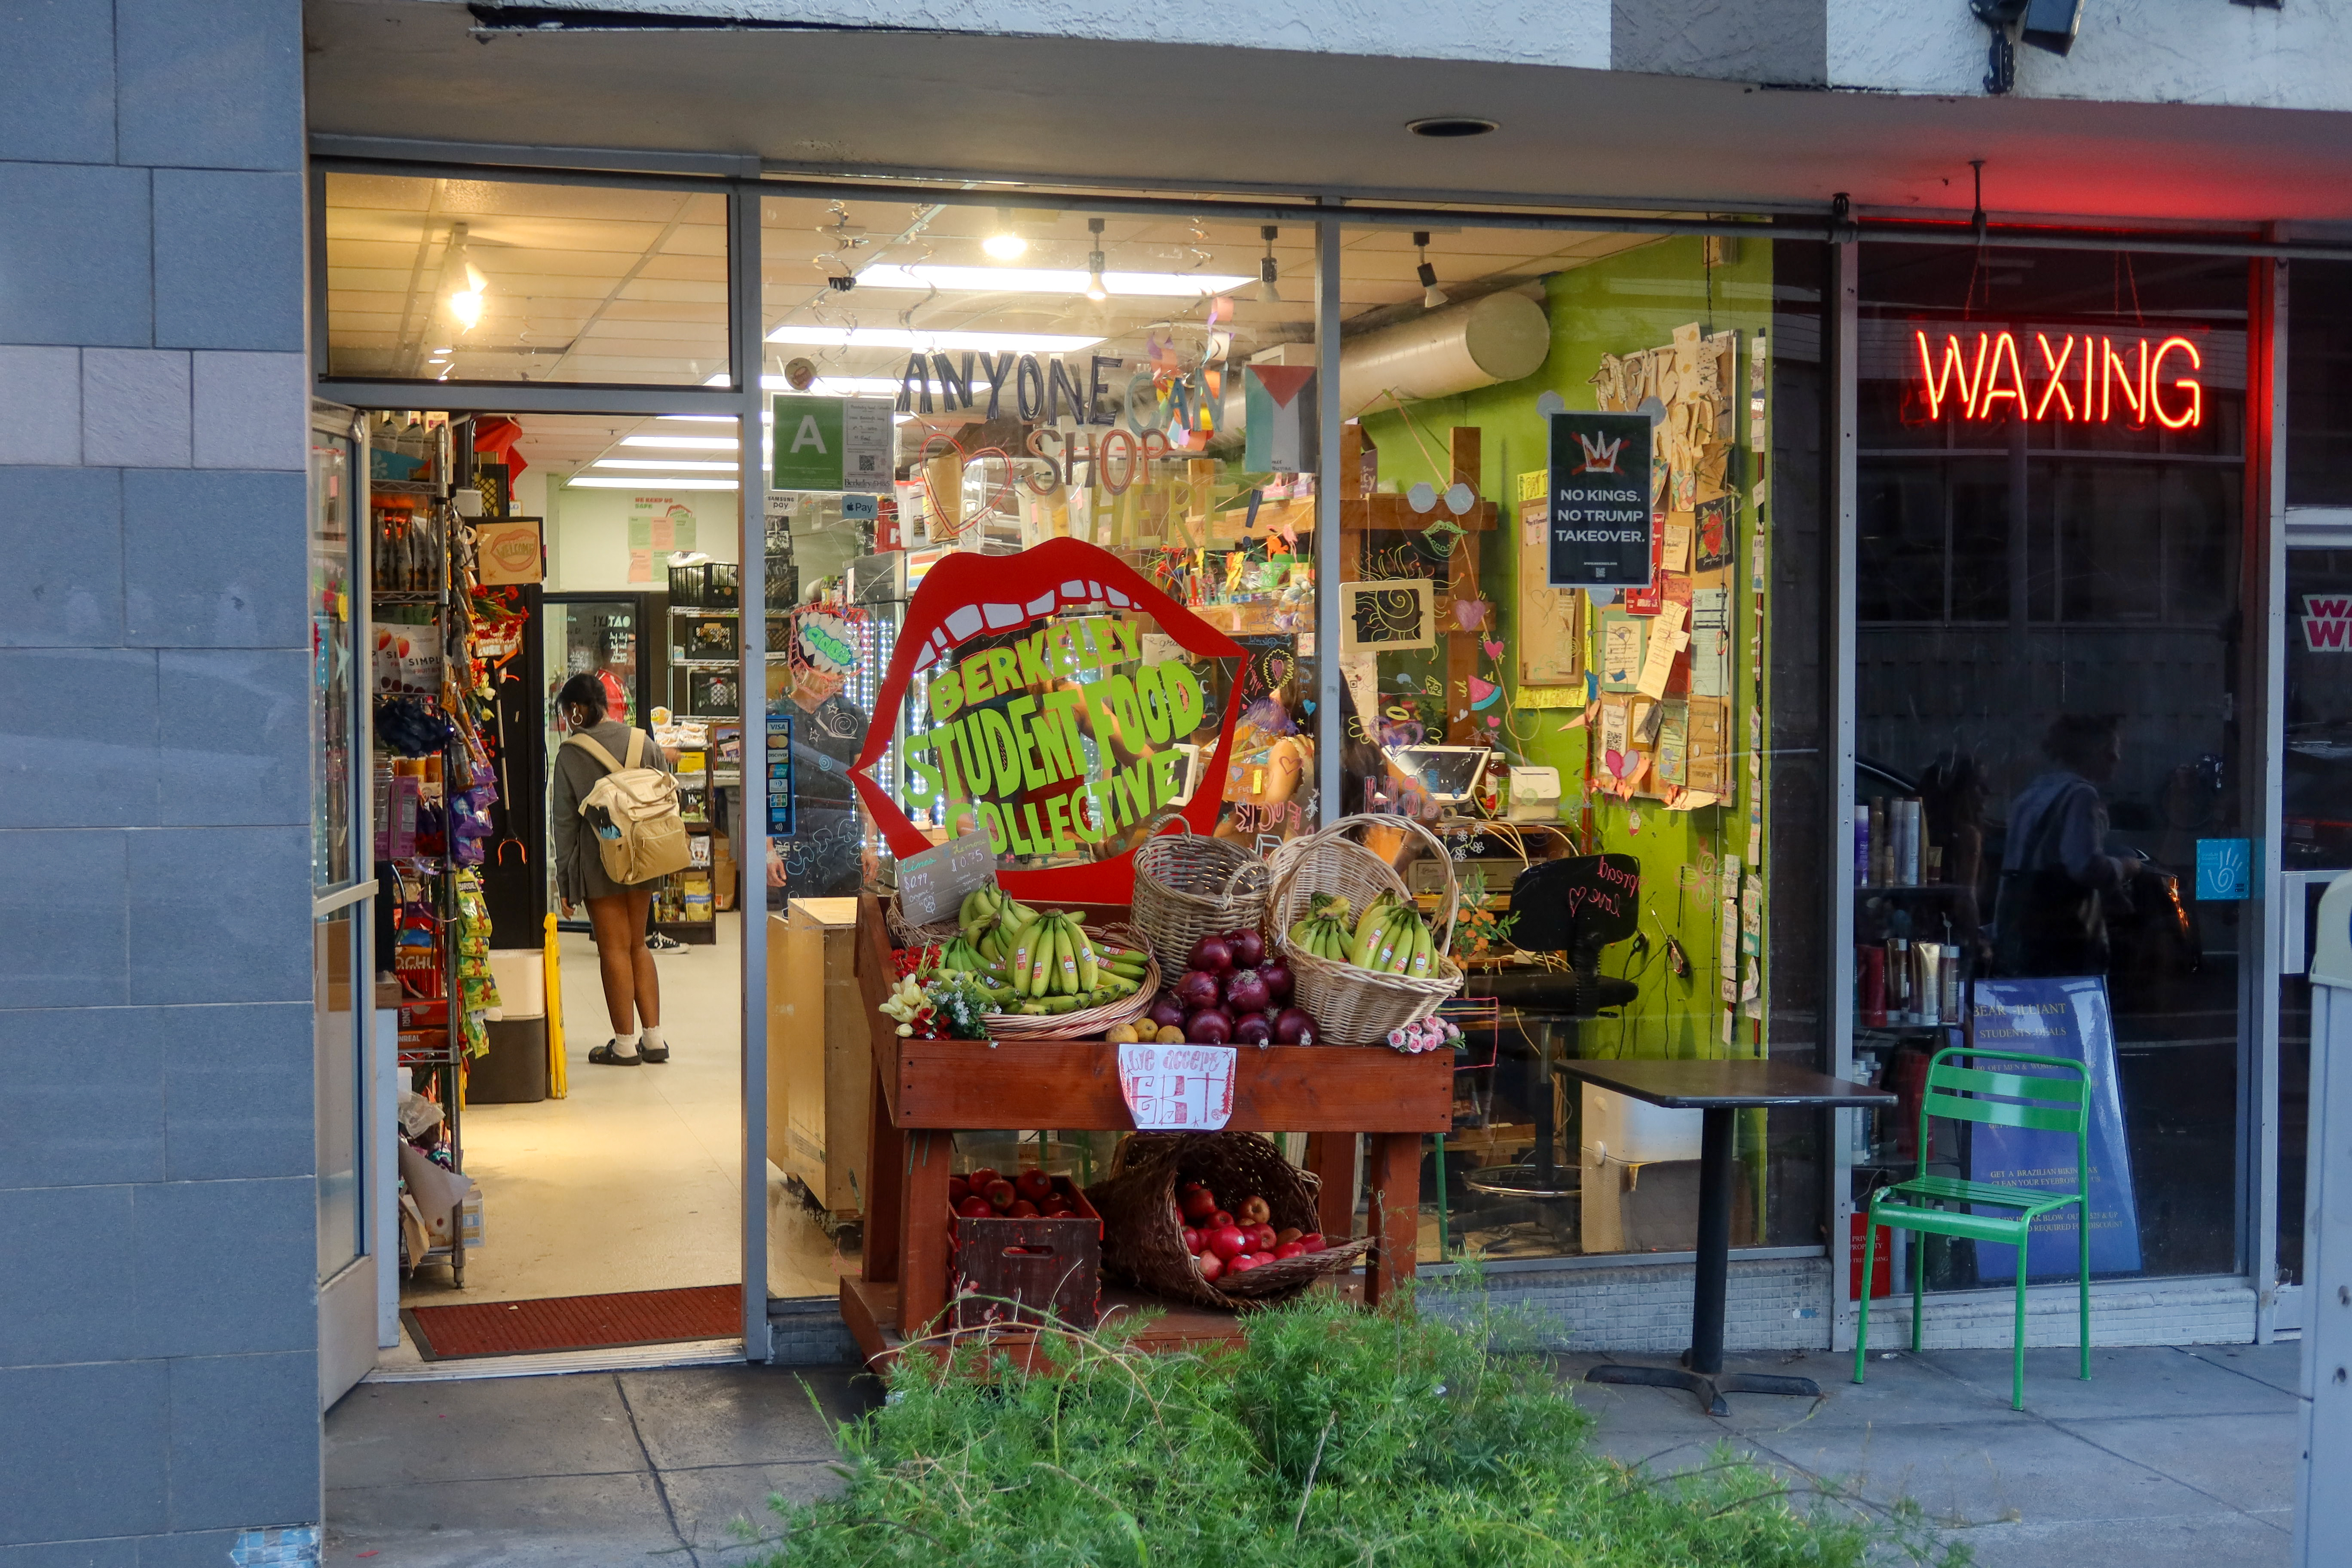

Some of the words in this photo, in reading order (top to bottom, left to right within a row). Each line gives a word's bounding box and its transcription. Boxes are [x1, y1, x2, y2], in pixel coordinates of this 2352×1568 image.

[895, 349, 1123, 428] ANYONE
[1917, 330, 2201, 429] WAXING
[790, 414, 828, 454] A
[1025, 428, 1170, 496] SHOP
[1560, 489, 1584, 501] NO
[1587, 490, 1641, 502] KINGS.
[855, 503, 873, 513] Pay
[1558, 509, 1582, 521] NO
[1583, 510, 1644, 522] TRUMP
[1555, 530, 1645, 542] TAKEOVER.
[929, 617, 1140, 722] BERKELEY
[900, 690, 1087, 809] STUDENT
[1084, 661, 1204, 771] FOOD
[945, 742, 1183, 855] COLLECTIVE
[904, 873, 928, 892] $0.99
[1980, 1029, 2031, 1038] STUDENTS
[1163, 1050, 1220, 1071] accept
[2058, 1167, 2079, 1175] BIKIN
[2041, 1177, 2075, 1185] EYEBROW
[2034, 1223, 2071, 1231] REQUIRED
